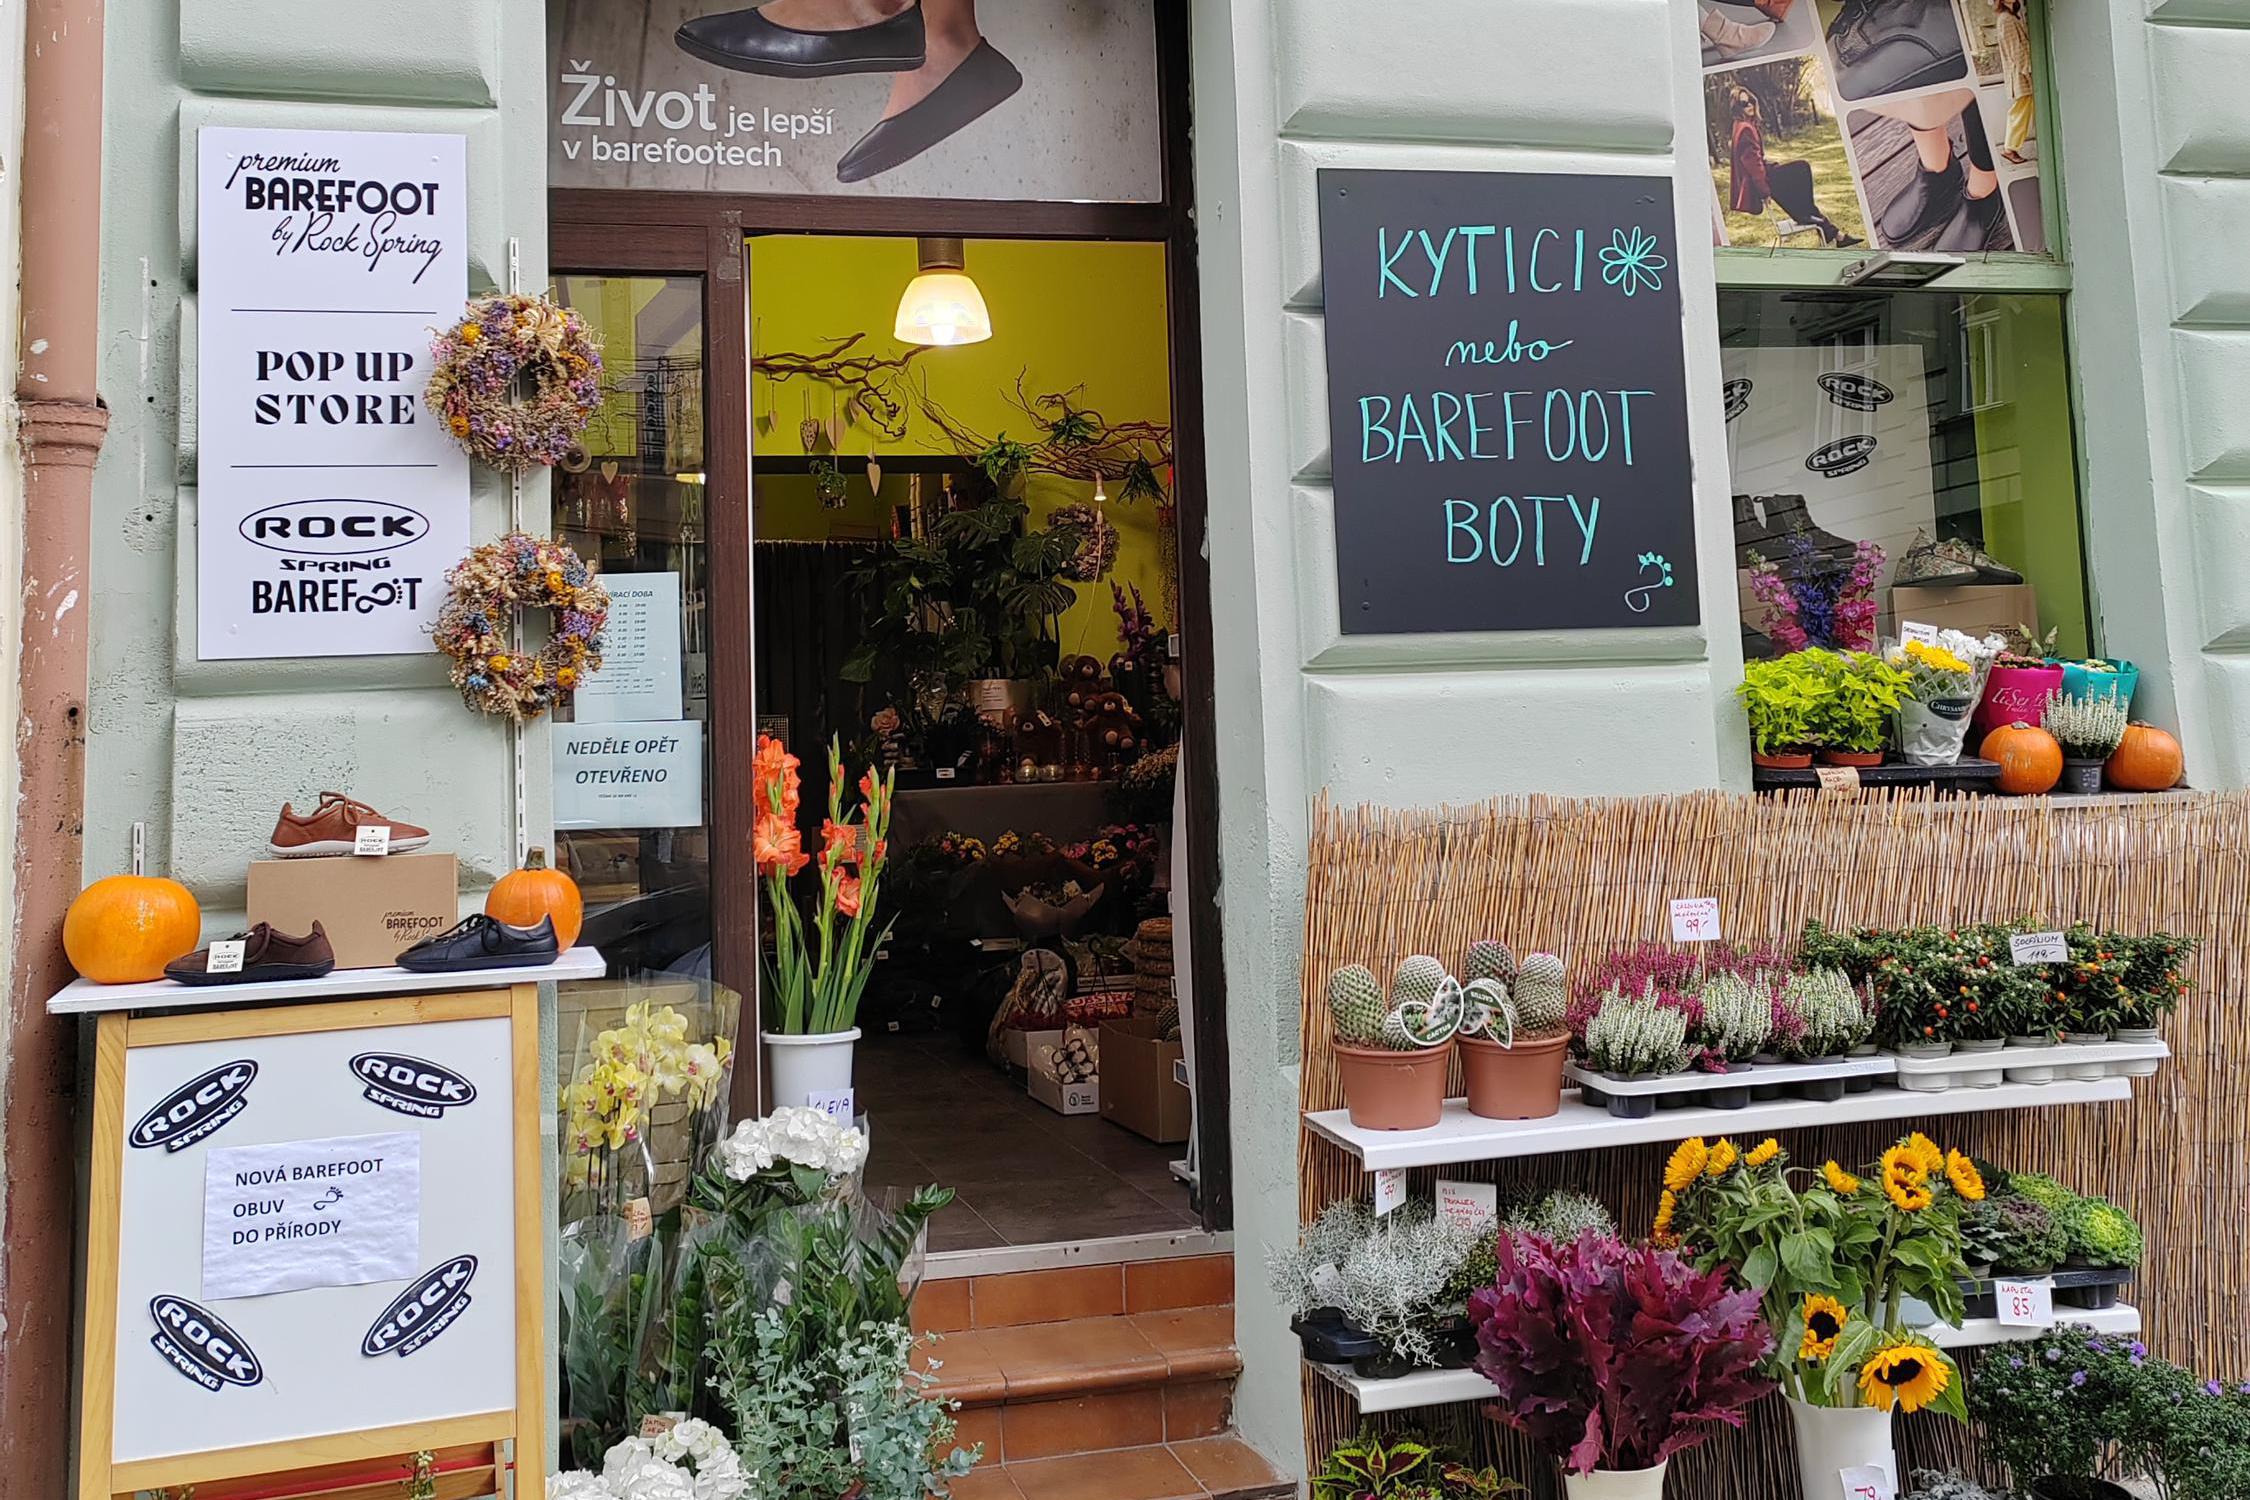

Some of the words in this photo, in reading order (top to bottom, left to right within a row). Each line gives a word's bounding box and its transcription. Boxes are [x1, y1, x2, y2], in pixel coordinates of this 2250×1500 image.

[561, 59, 717, 131] Život
[724, 106, 756, 137] je
[763, 107, 836, 140] lepší
[562, 140, 582, 160] v
[592, 135, 782, 167] barefootech
[225, 153, 341, 189] premium
[245, 177, 439, 215] BAREFOOT
[272, 216, 294, 256] by
[292, 211, 361, 253] Rock
[363, 210, 443, 284] Spring
[1378, 225, 1584, 298] KYTICI
[1445, 320, 1574, 366] nebo
[256, 351, 345, 382] POP
[355, 352, 414, 382] UP
[1825, 378, 1887, 400] ROCK
[255, 393, 415, 425] STORE
[1358, 388, 1656, 465] BAREFOOT
[1812, 439, 1871, 467] ROCK
[255, 515, 415, 539] ROCK
[1443, 494, 1600, 567] BOTY
[280, 557, 391, 573] SPRING
[566, 736, 630, 755] NEDĚLE
[634, 736, 679, 753] OPĚT
[575, 766, 668, 784] OTEVŘENO
[387, 916, 443, 929] BAREFOOT
[1470, 991, 1494, 1003] CACTUS
[1426, 1023, 1452, 1040] CACTUS
[361, 1059, 467, 1100] ROCK
[141, 1067, 248, 1140] ROCK
[367, 1088, 440, 1117] SPRING
[169, 1100, 243, 1149] SPRING
[235, 1165, 287, 1187] NOVÁ
[293, 1158, 384, 1181] BAREFOOT
[233, 1199, 284, 1217] OBUV
[233, 1228, 259, 1245] DO
[265, 1219, 342, 1242] PŘÍRODY
[372, 1262, 468, 1350] ROCK
[401, 1295, 468, 1354] SPRING
[160, 1302, 253, 1380] ROCK
[154, 1335, 220, 1390] SPRING
